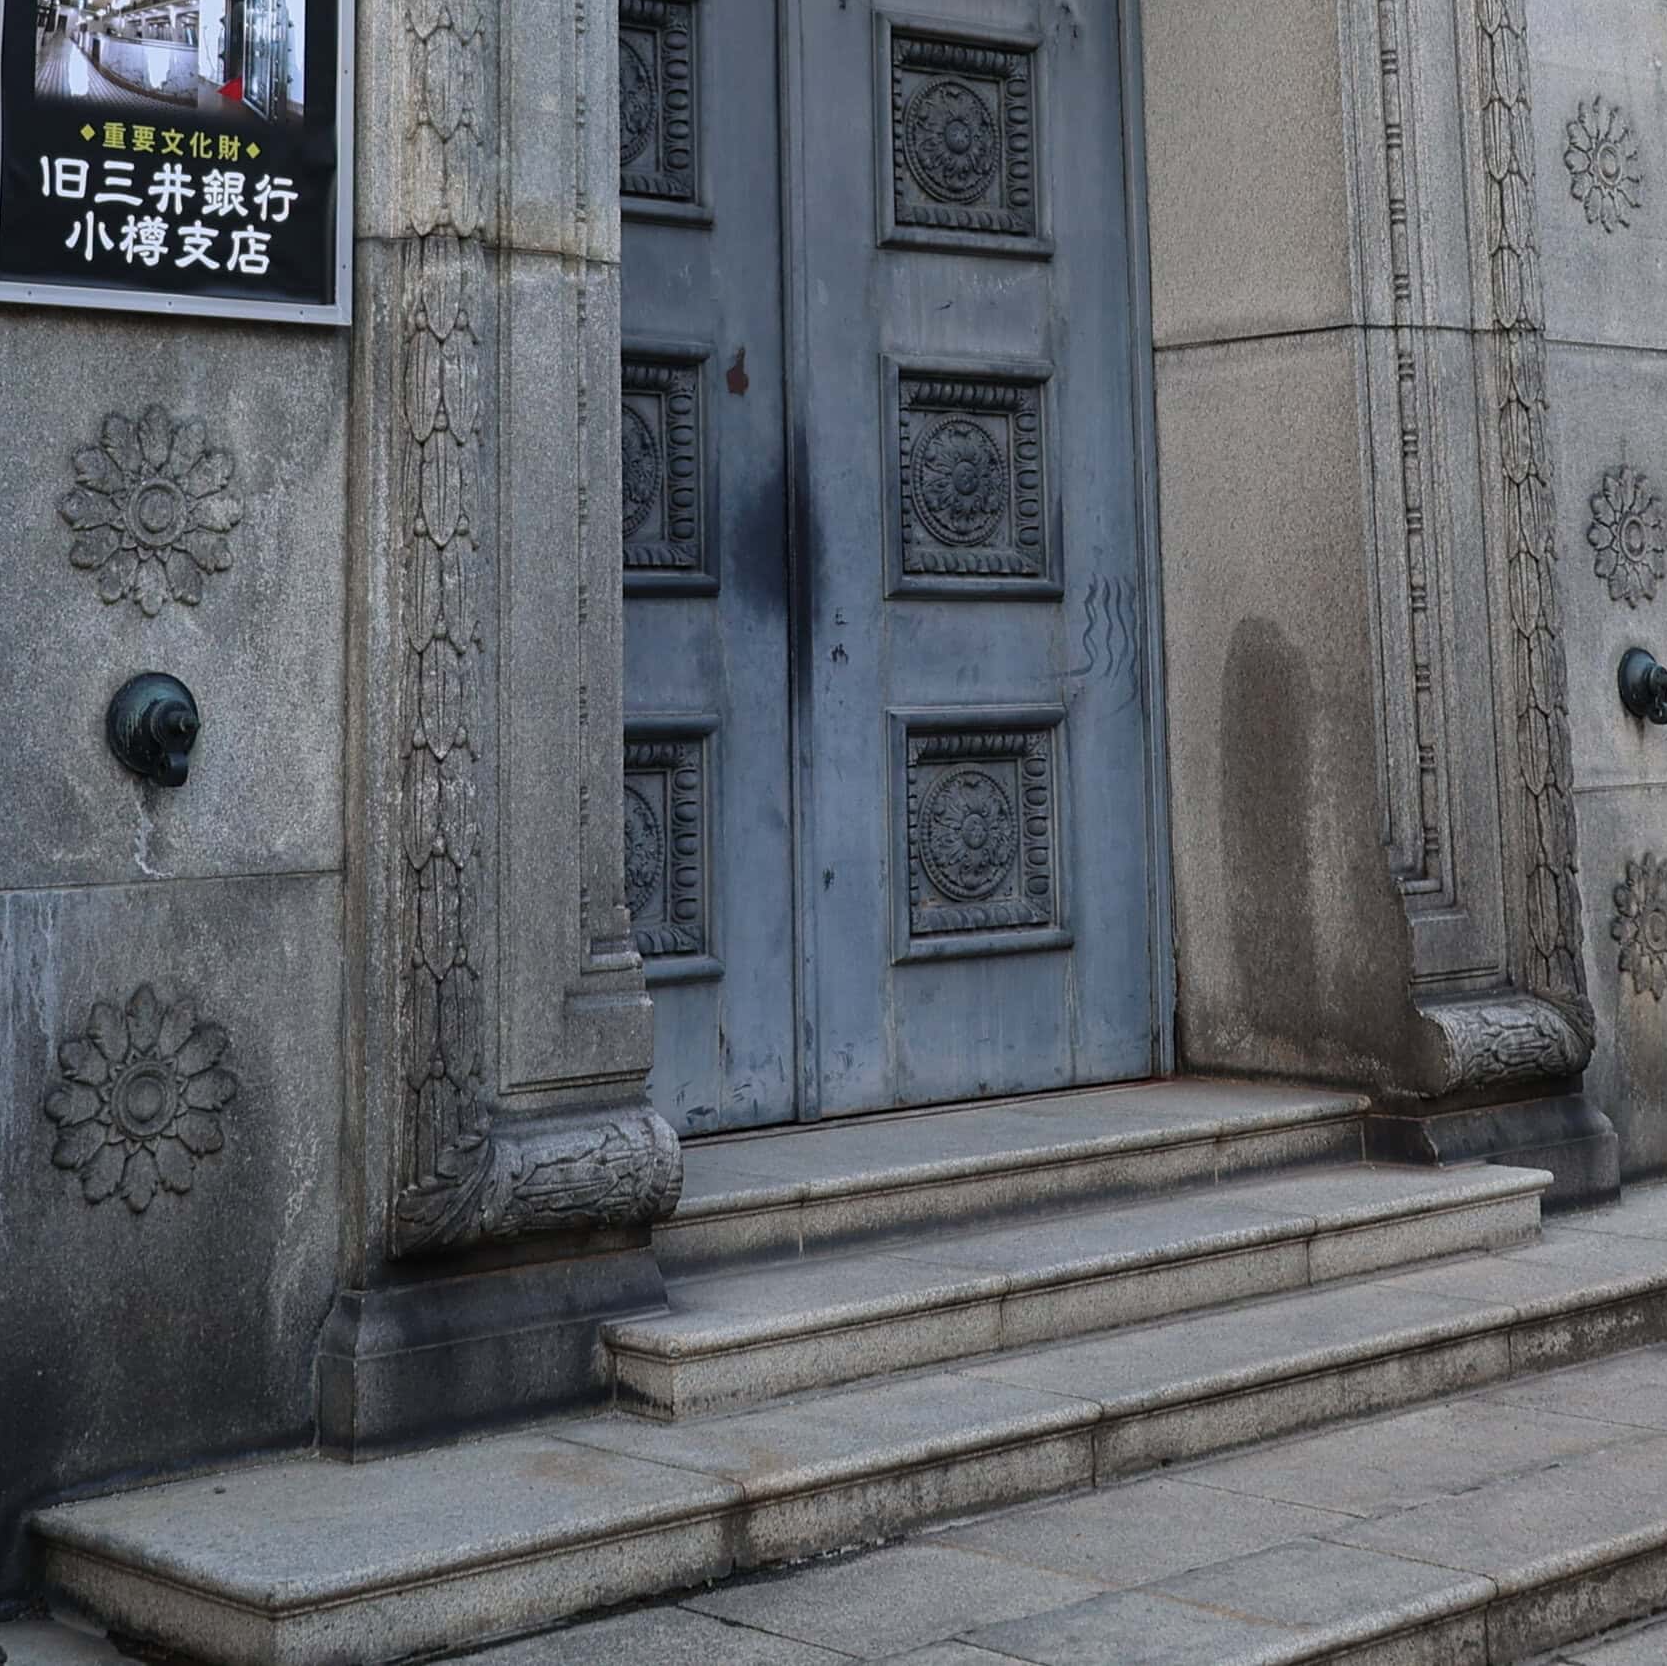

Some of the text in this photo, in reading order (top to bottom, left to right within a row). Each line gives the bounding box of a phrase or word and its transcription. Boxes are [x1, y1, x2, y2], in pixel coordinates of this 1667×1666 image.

[101, 121, 242, 162] 重要文化財
[39, 154, 300, 223] 旧三井銀行
[64, 210, 273, 275] 小樽支店
